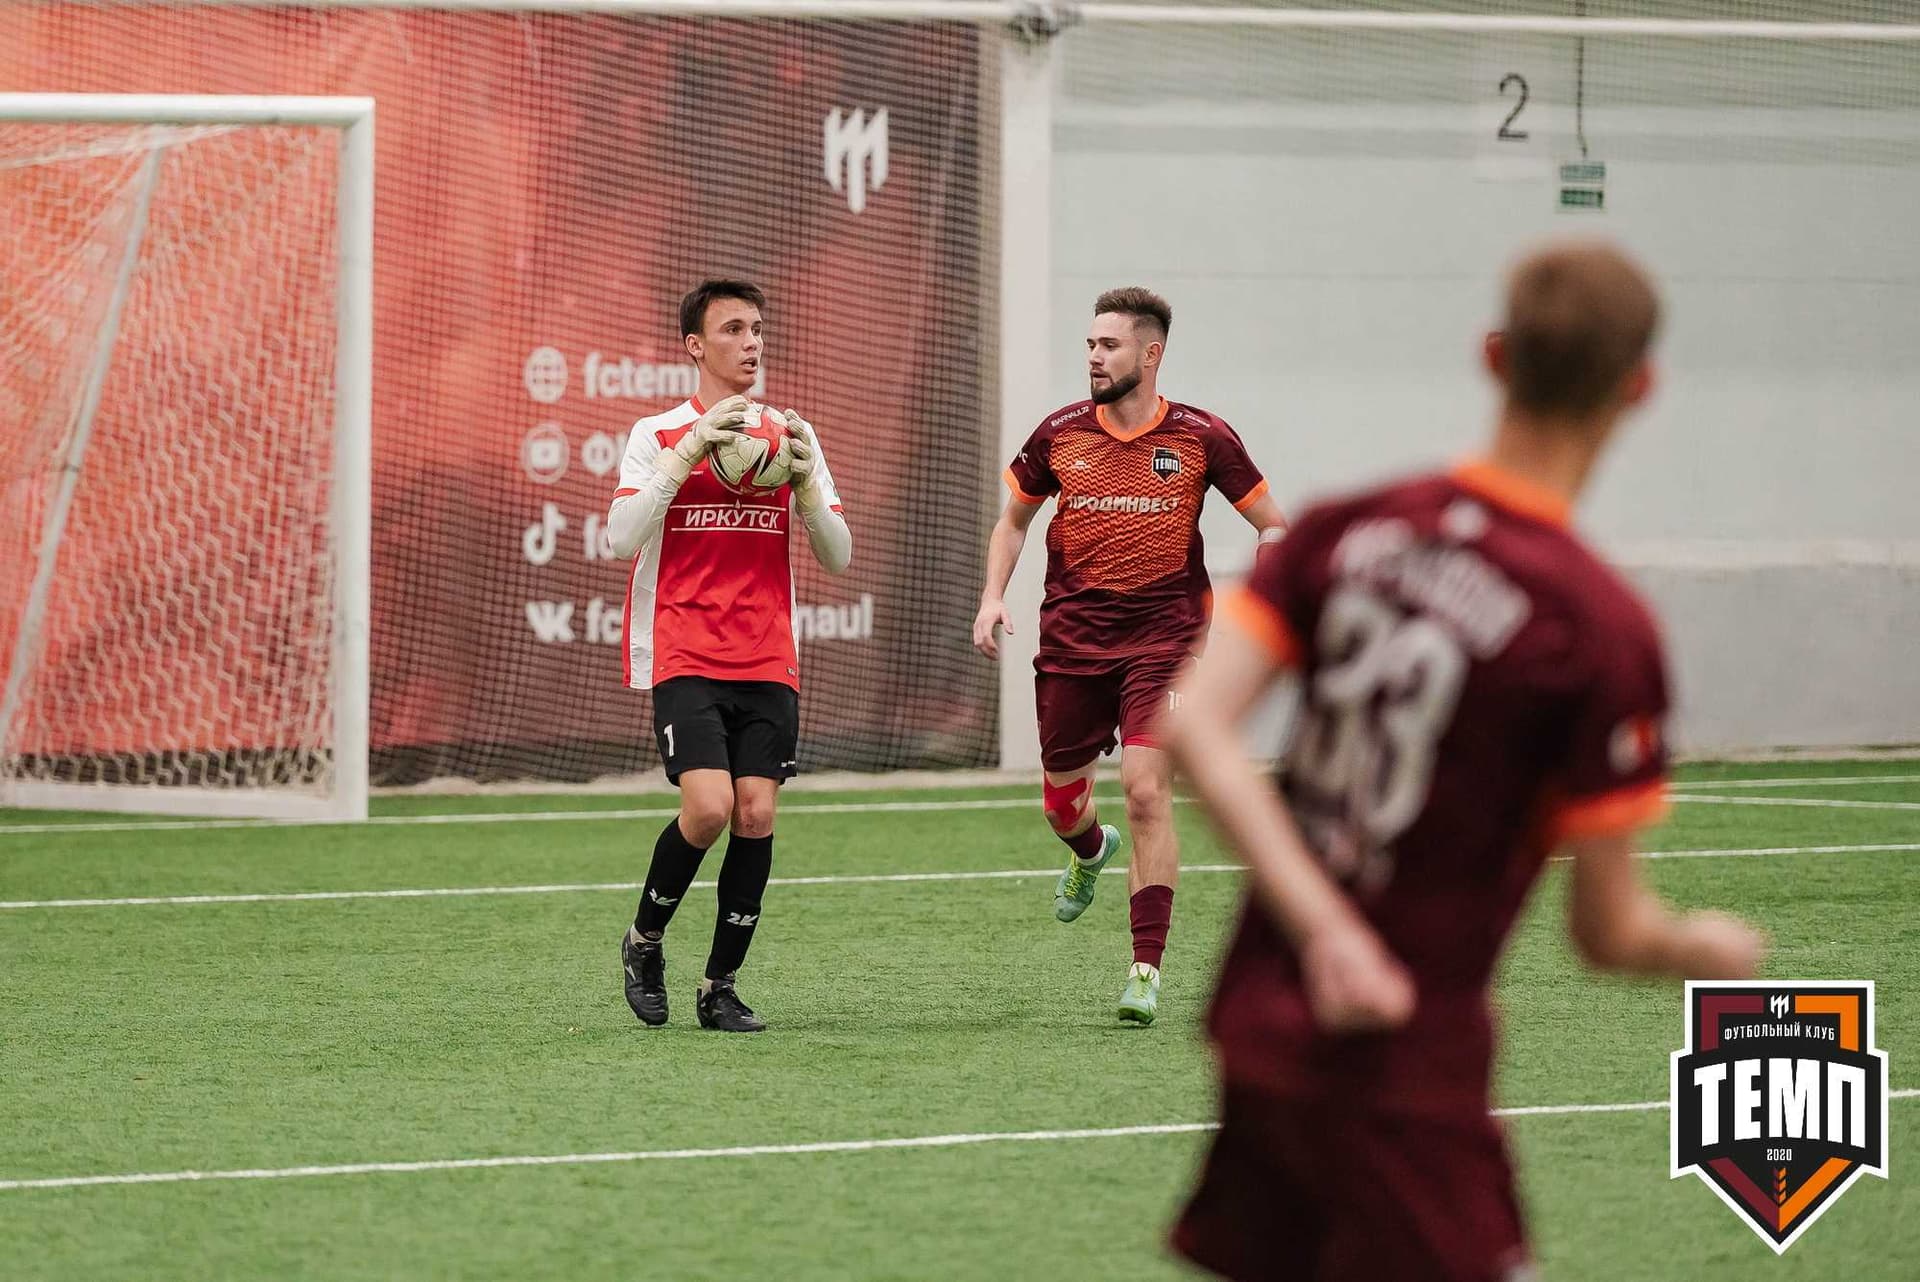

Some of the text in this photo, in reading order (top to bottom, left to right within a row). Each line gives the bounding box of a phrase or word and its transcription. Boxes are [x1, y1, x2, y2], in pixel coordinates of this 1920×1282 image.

[1498, 73, 1529, 141] 2
[685, 509, 780, 528] ИРКУТСК
[665, 724, 674, 757] 1
